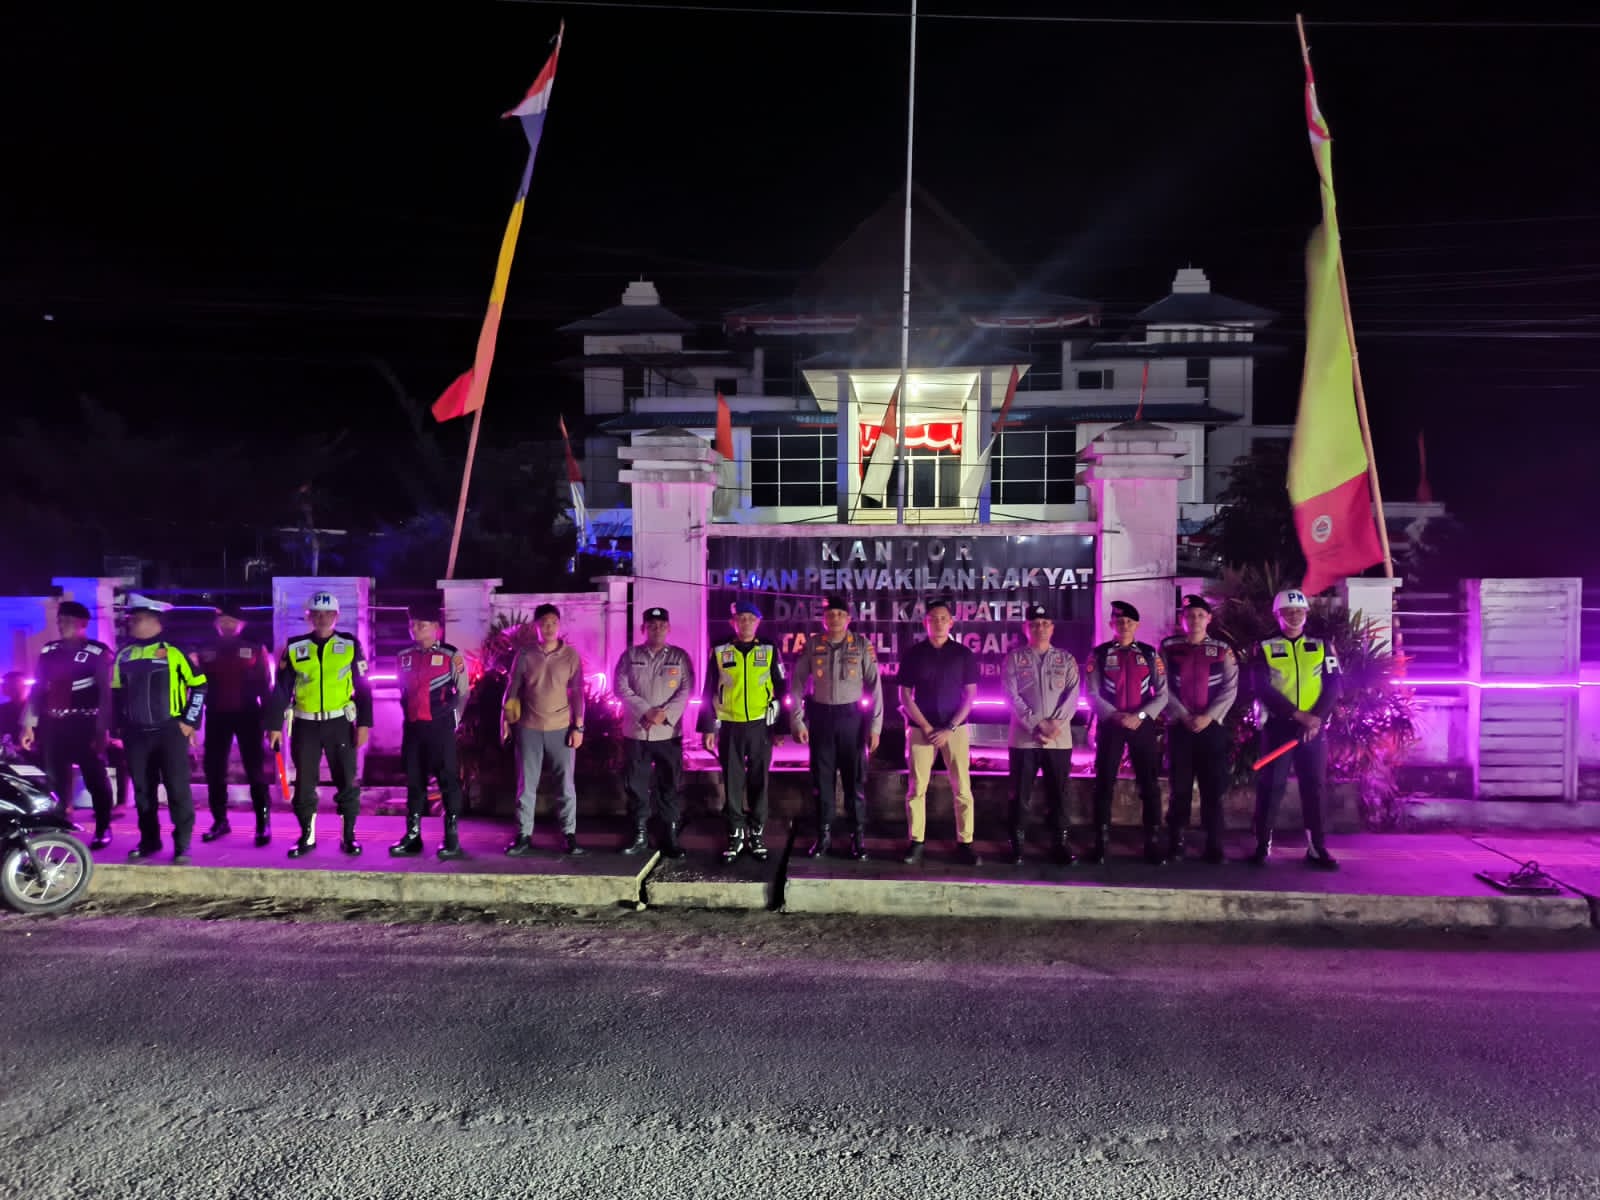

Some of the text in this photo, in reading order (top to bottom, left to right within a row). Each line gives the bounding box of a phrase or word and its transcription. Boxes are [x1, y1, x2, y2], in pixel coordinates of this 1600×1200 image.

[822, 540, 973, 561] KANTOR
[708, 567, 1093, 591] DEWAN PERWAKILAN RAKYAT
[314, 595, 330, 605] PM
[775, 600, 876, 622] DAEAH
